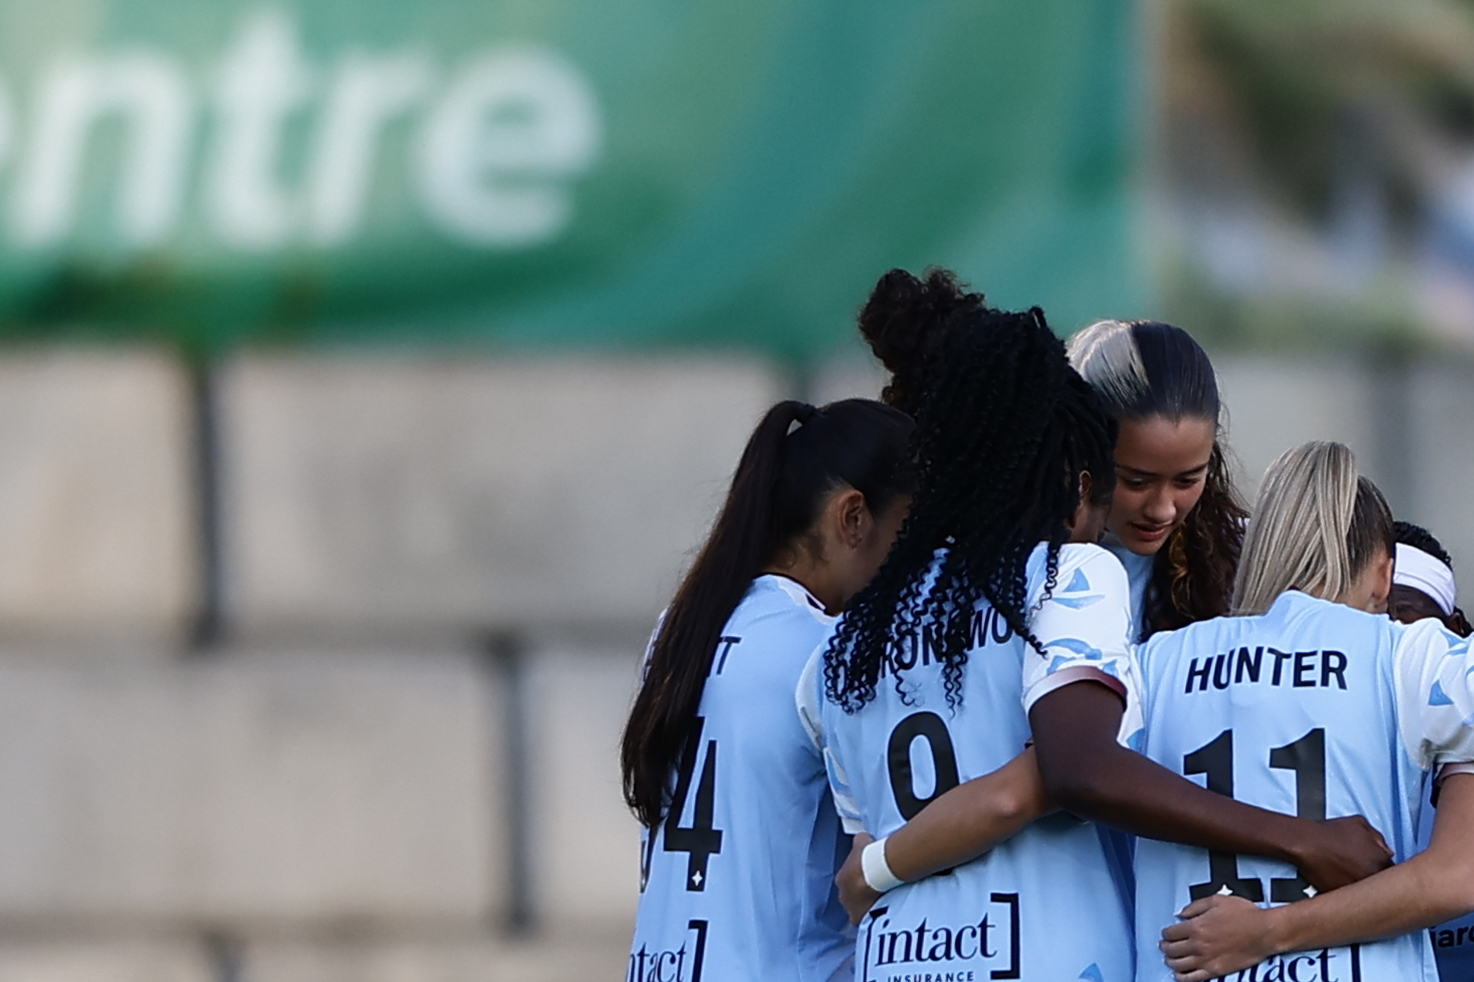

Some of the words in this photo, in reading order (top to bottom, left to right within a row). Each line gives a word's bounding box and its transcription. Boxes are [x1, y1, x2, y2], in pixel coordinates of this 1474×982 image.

[0, 14, 604, 248] ntre
[1184, 646, 1349, 693] HUNTER
[1183, 727, 1327, 905] 11
[874, 912, 998, 967] intact
